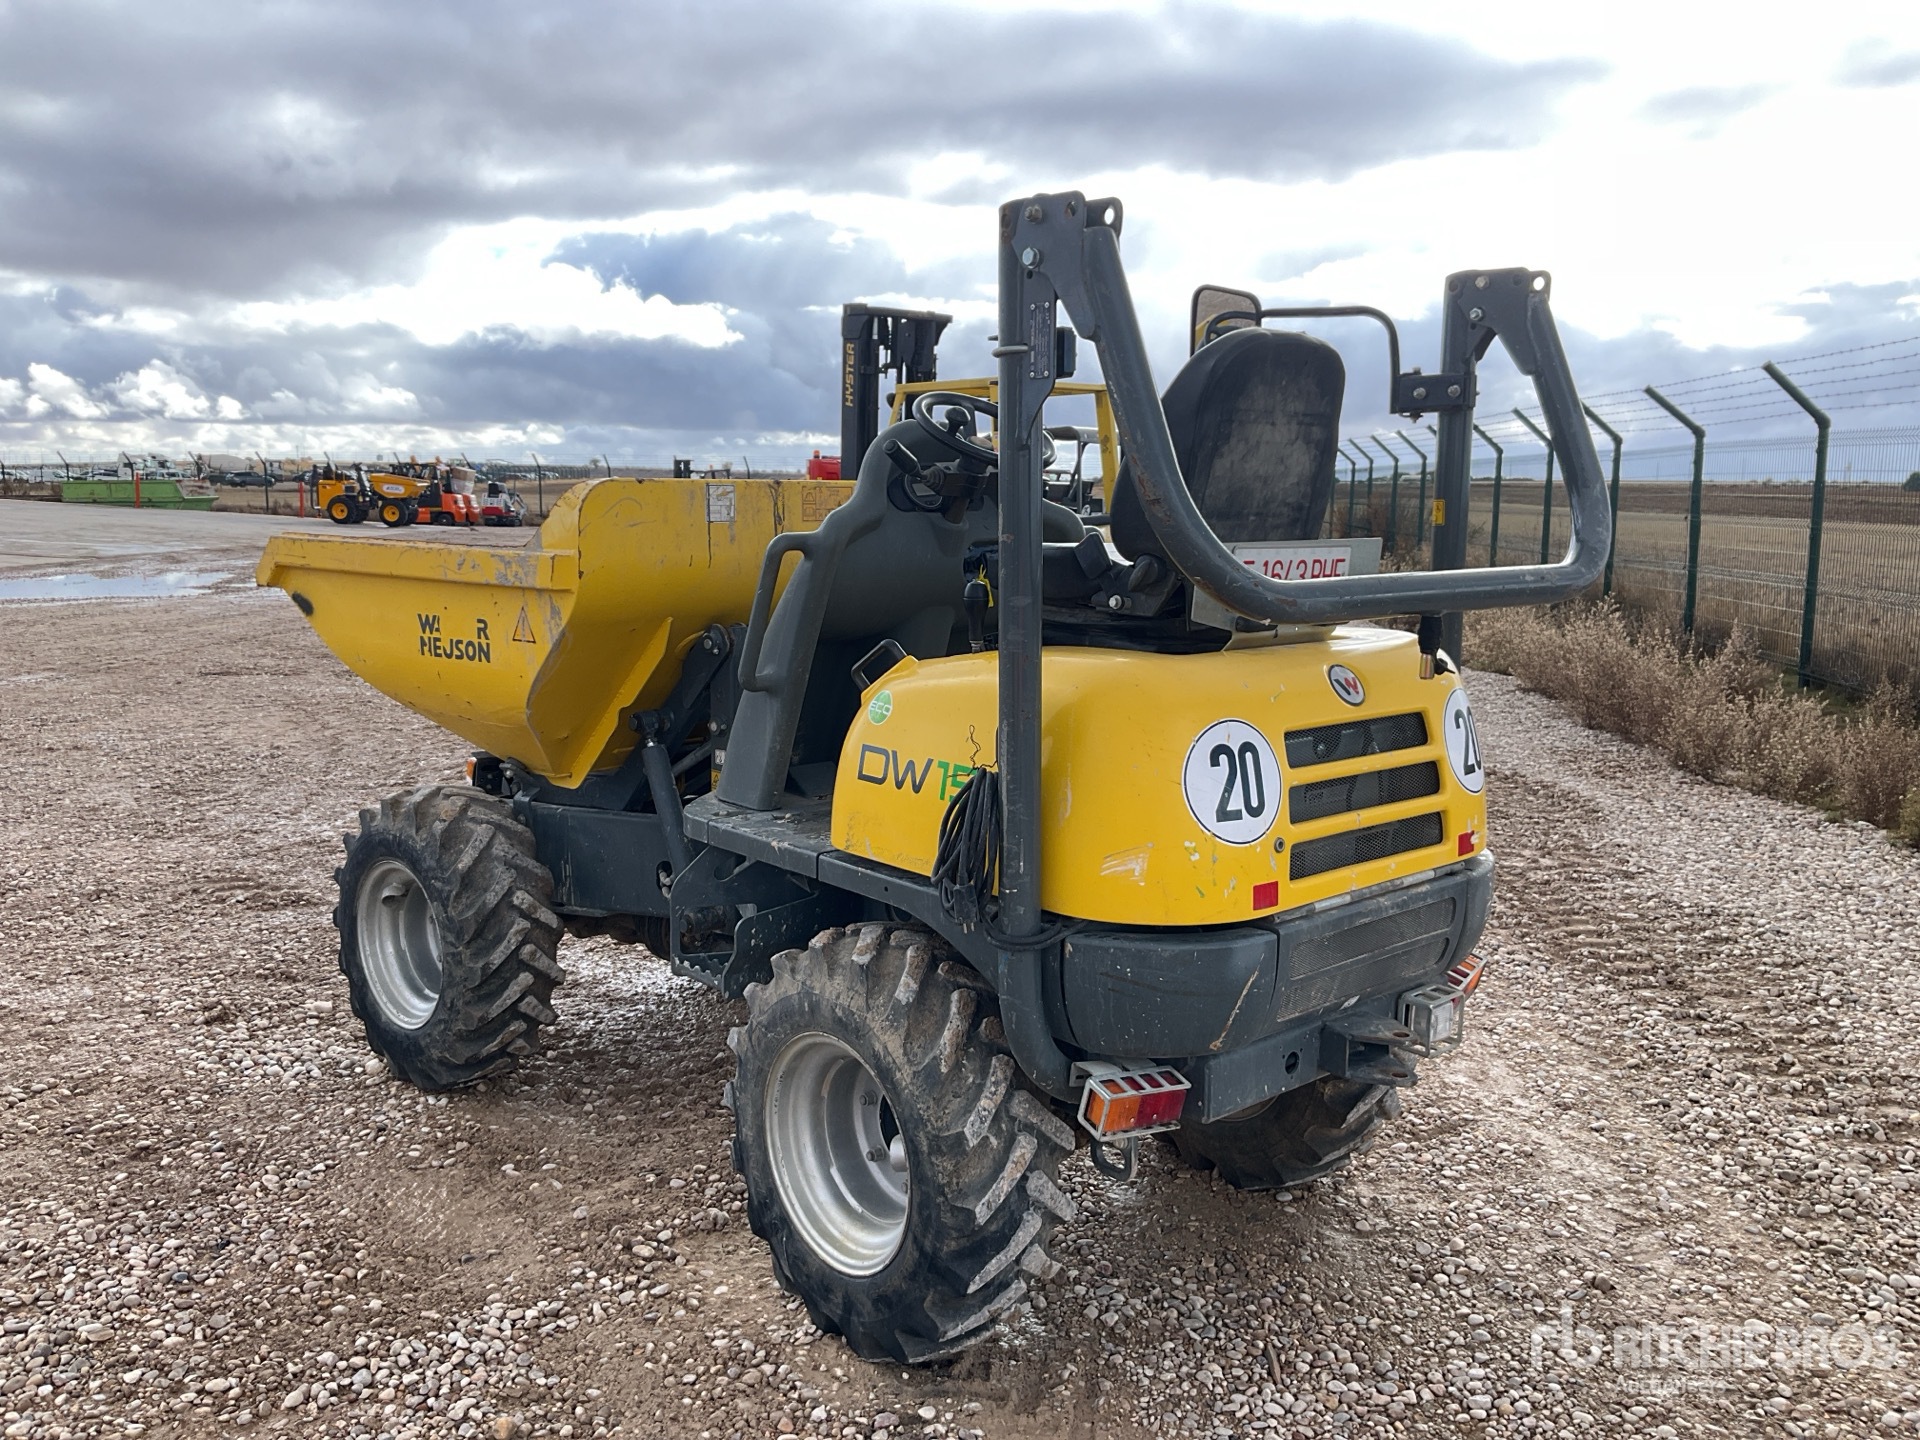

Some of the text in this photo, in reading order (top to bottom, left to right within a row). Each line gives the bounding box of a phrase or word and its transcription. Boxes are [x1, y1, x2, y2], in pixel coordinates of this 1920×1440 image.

[844, 342, 855, 407] HYSTER
[869, 700, 892, 716] ECO
[1454, 706, 1482, 776] 20
[1209, 741, 1266, 823] 20
